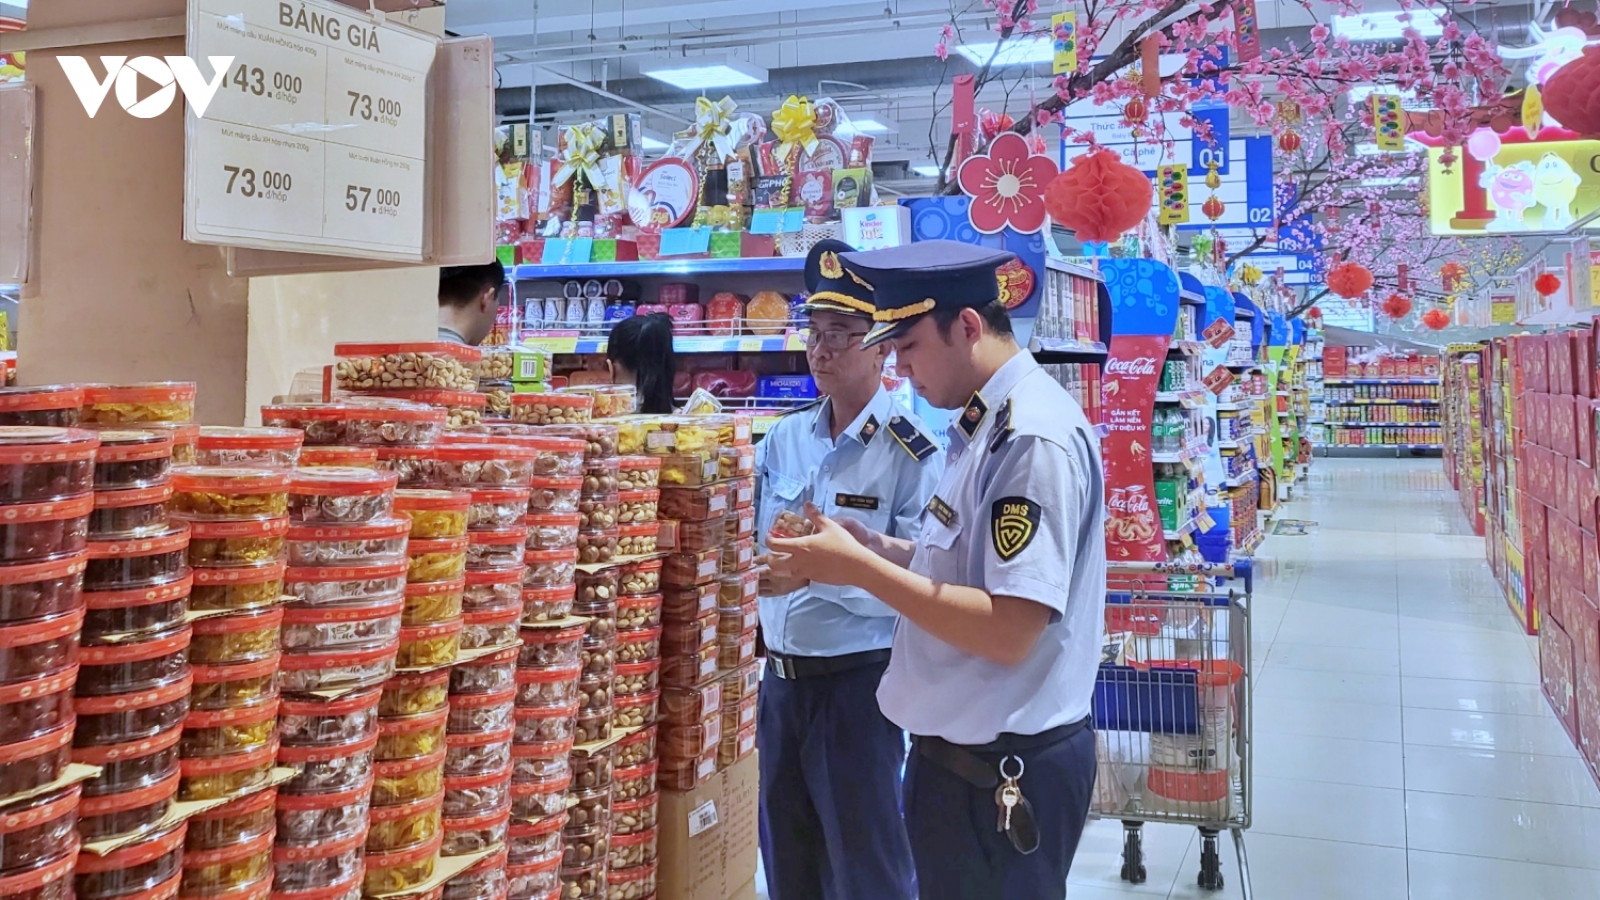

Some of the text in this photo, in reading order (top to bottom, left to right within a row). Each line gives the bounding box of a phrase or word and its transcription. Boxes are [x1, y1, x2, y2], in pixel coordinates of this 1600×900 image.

[279, 2, 381, 54] BẢNG GIÁ
[1090, 121, 1115, 131] Thức
[1138, 147, 1156, 157] phê
[1199, 147, 1225, 169] 01
[1249, 207, 1272, 223] 02
[859, 219, 883, 228] Kinder
[1280, 239, 1297, 252] 03
[1298, 260, 1313, 271] 04
[1104, 356, 1158, 375] Coca-Cola
[1003, 503, 1029, 517] DMS
